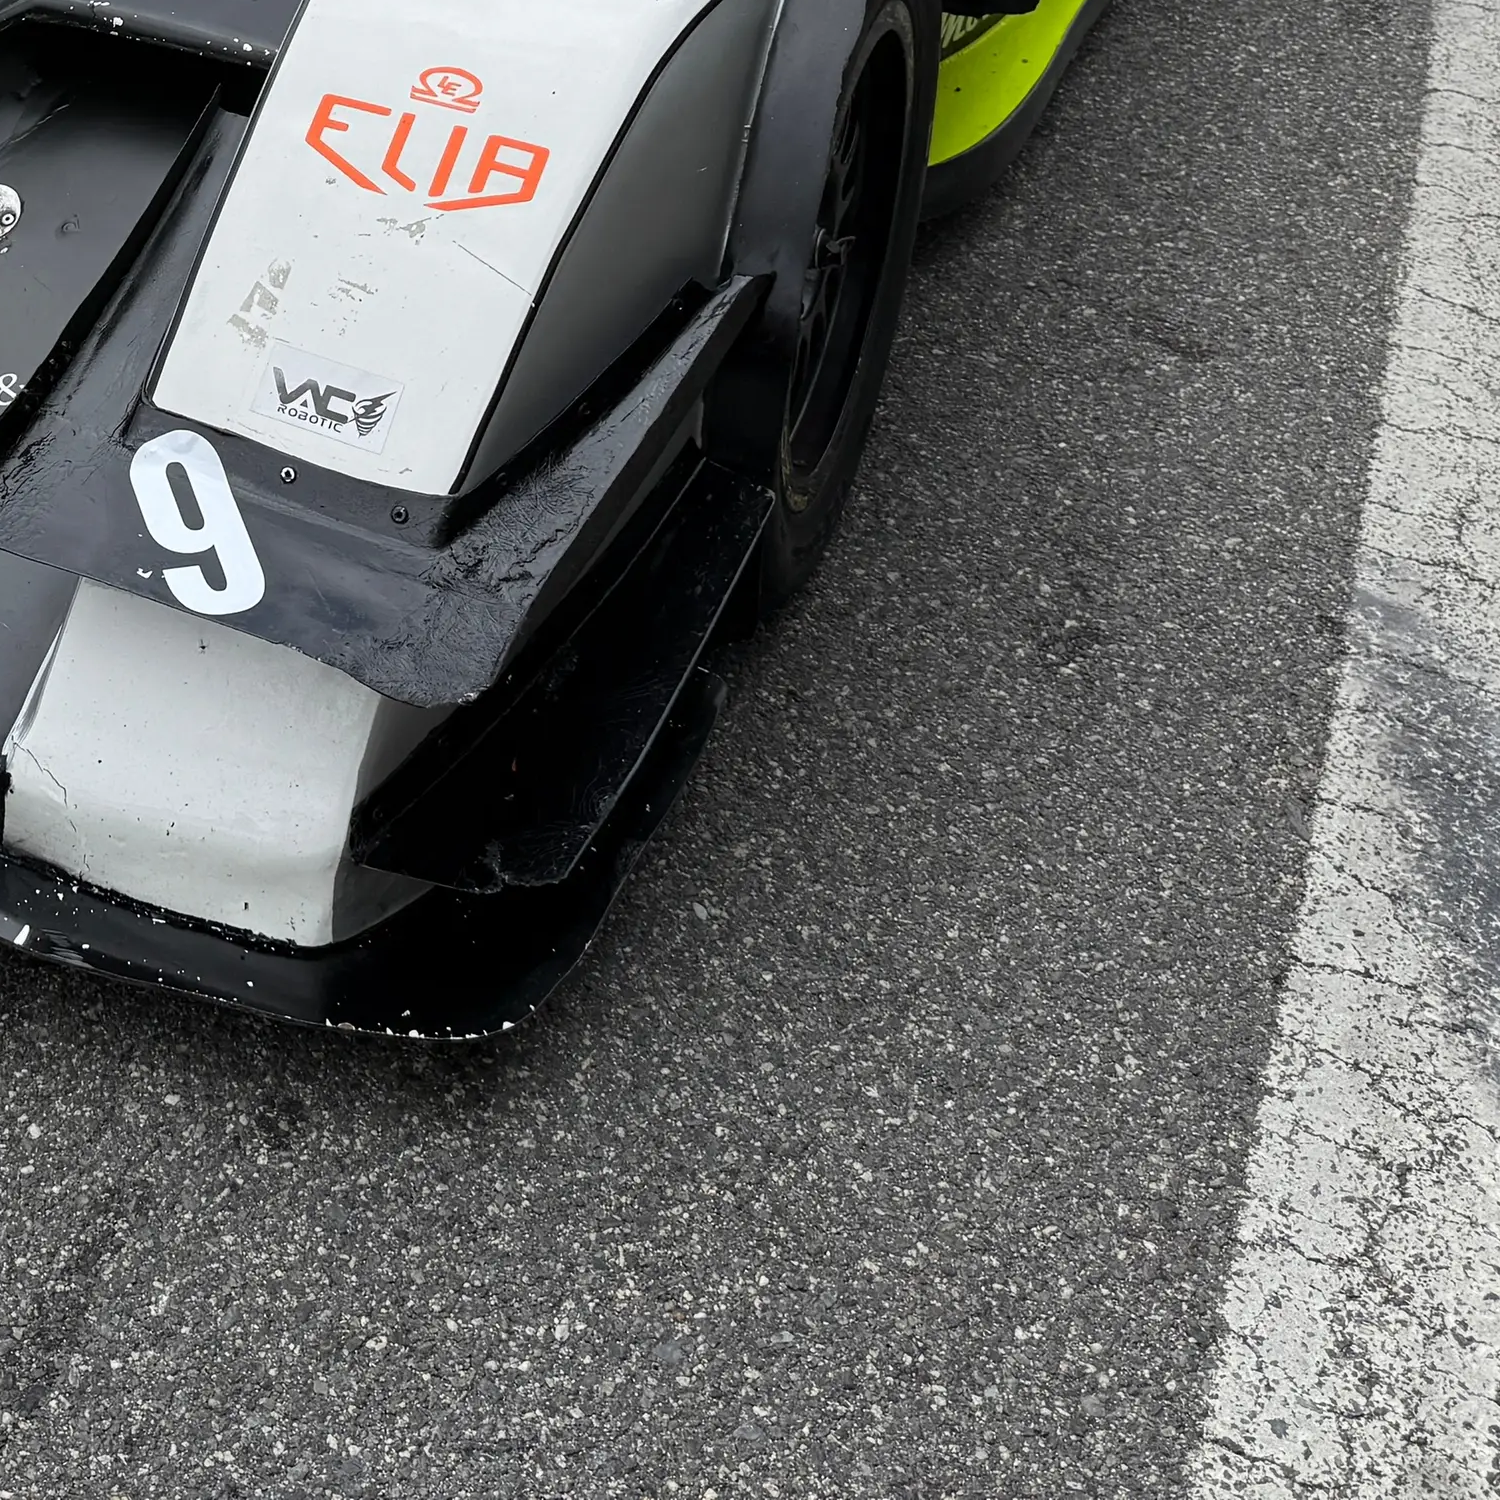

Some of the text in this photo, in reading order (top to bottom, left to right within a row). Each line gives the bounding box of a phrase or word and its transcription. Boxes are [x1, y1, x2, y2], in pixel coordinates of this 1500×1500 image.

[306, 94, 550, 212] ELIA
[277, 403, 344, 433] ROBOTIC
[129, 429, 266, 615] 9
